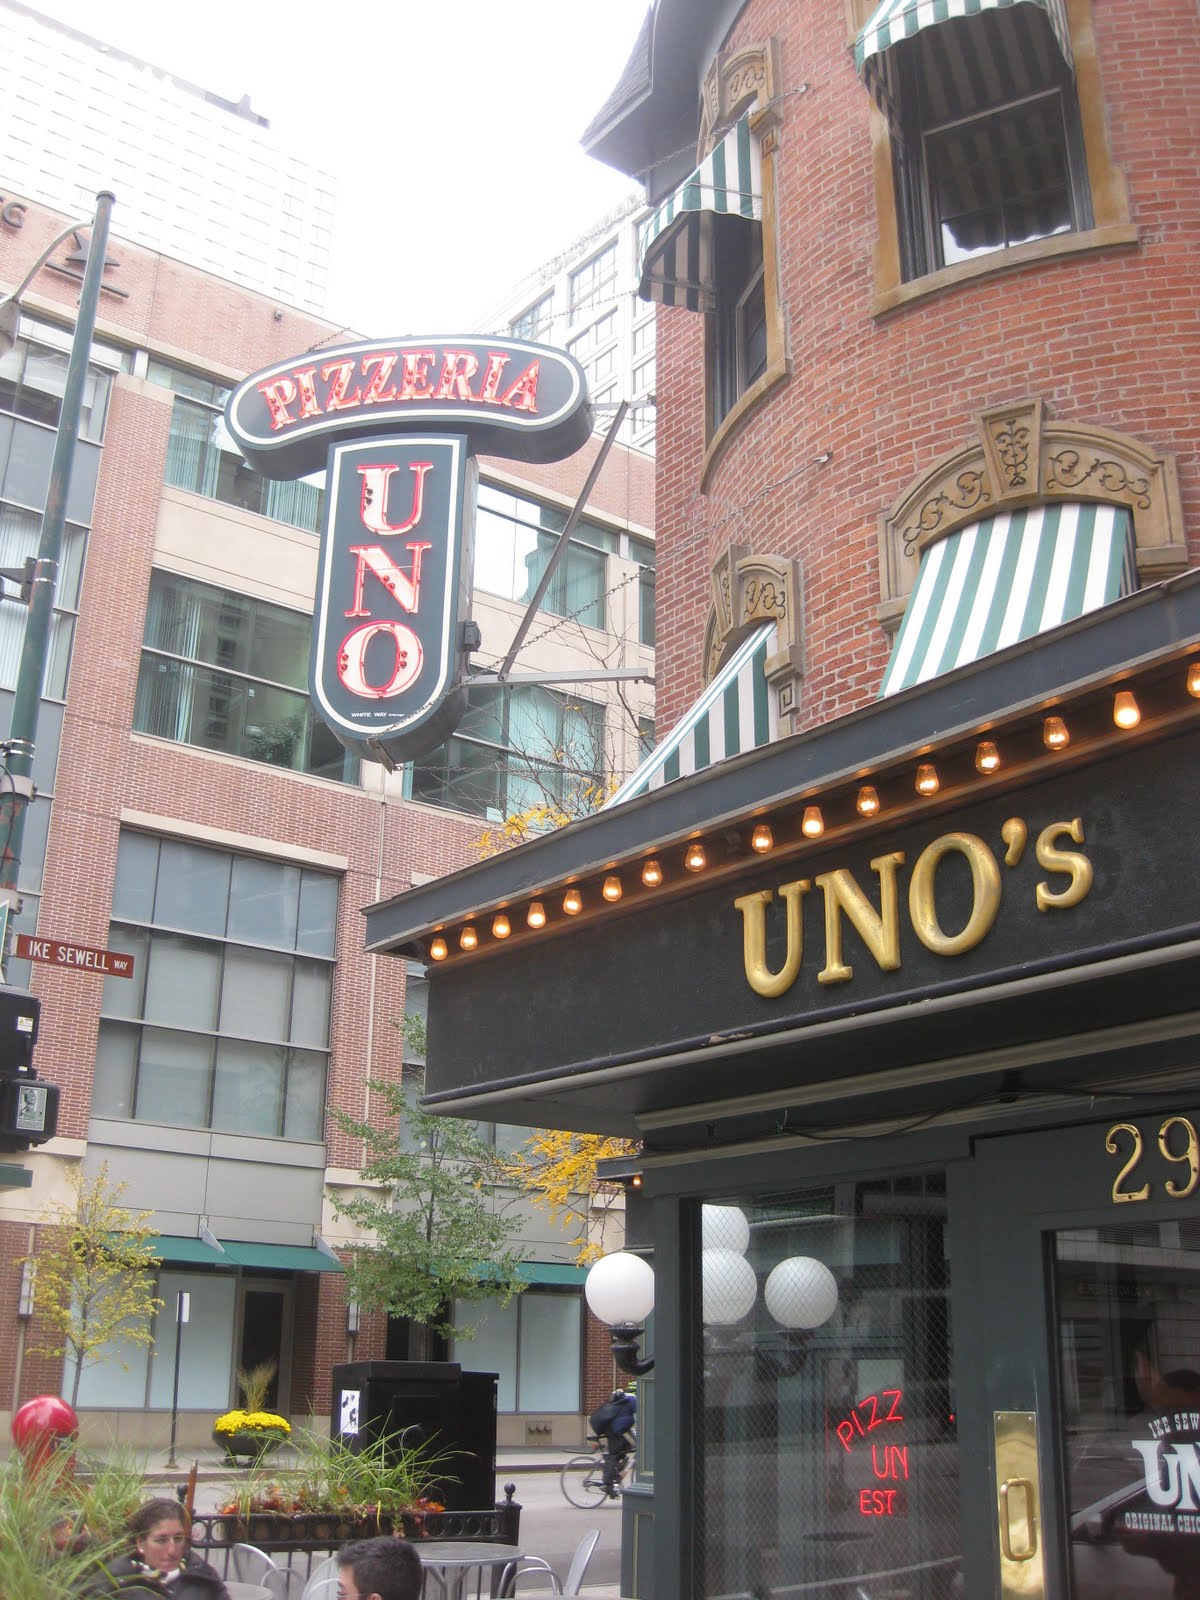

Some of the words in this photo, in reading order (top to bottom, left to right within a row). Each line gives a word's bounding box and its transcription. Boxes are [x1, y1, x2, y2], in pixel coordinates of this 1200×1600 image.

[257, 349, 539, 430] PIZZERIA
[337, 462, 433, 699] UNO
[733, 816, 1094, 998] UNO'S
[29, 940, 51, 959] IKE
[58, 946, 109, 970] SEWELL
[114, 959, 128, 970] WAY
[1105, 1116, 1200, 1204] 29
[836, 1389, 904, 1454] PIZZ
[1148, 1416, 1171, 1439] IKE
[1174, 1412, 1200, 1431] SEW
[871, 1444, 909, 1480] UN
[859, 1488, 897, 1516] EST
[1125, 1511, 1175, 1532] ORIGINAL
